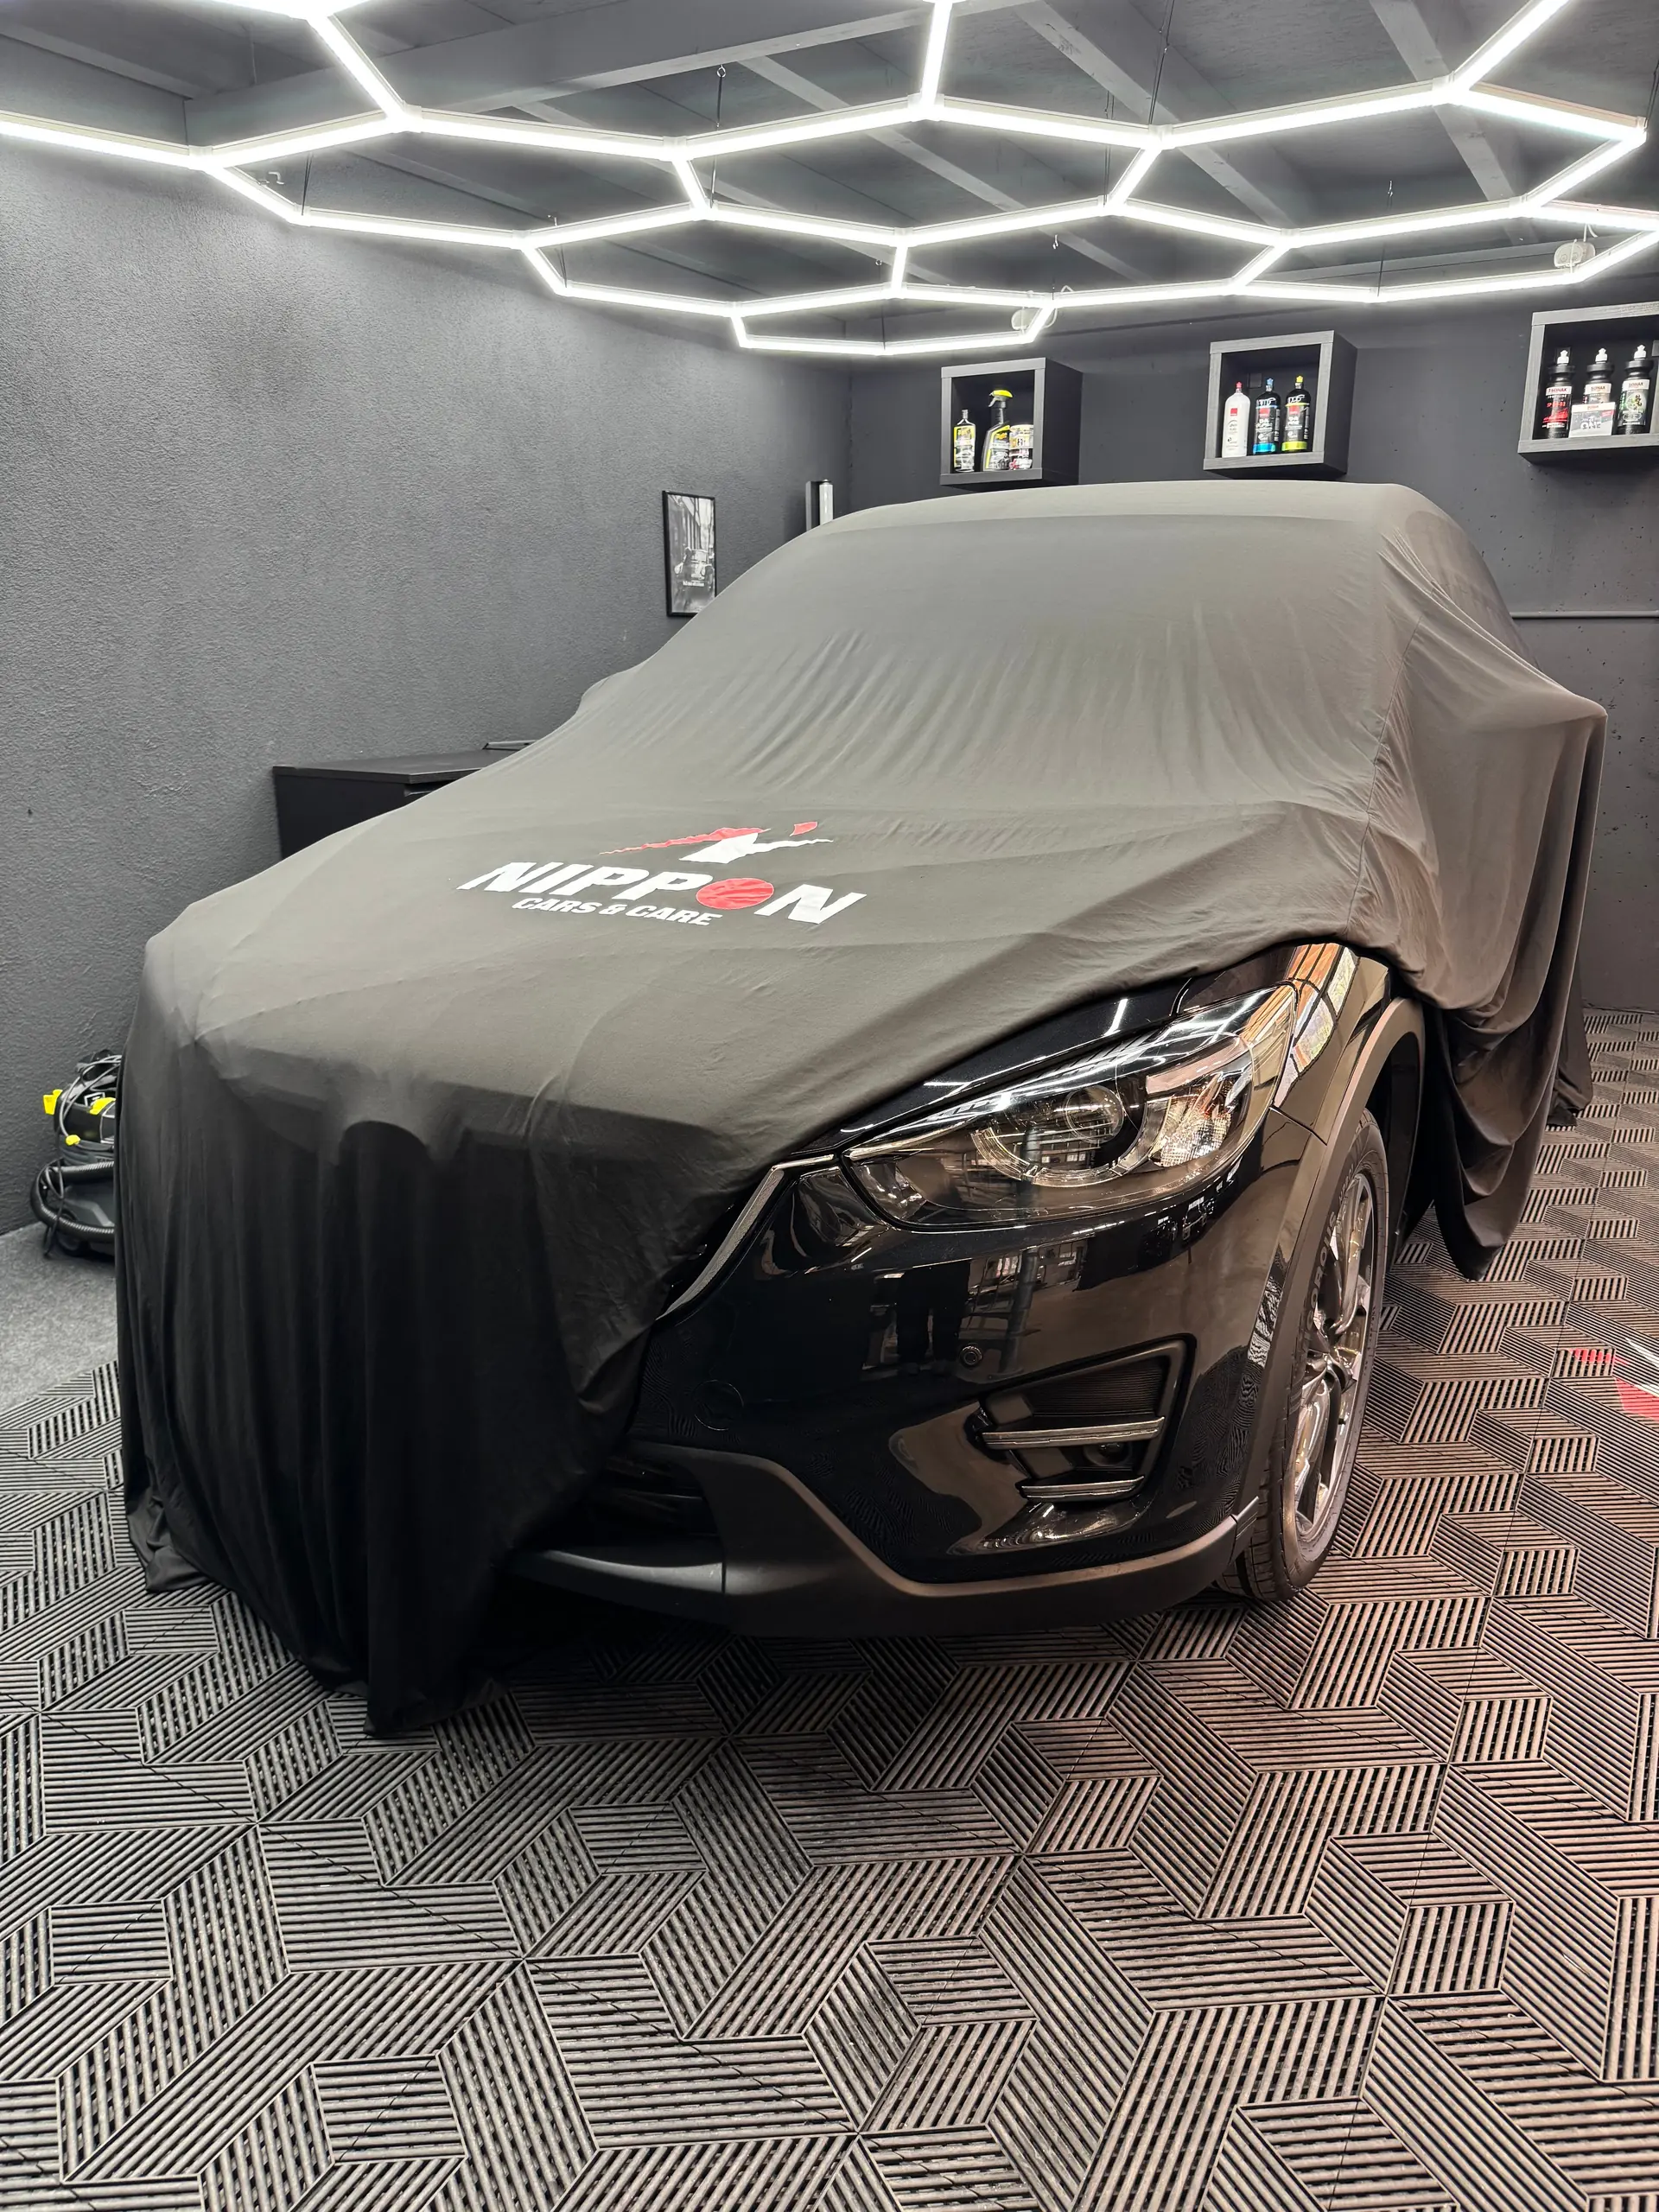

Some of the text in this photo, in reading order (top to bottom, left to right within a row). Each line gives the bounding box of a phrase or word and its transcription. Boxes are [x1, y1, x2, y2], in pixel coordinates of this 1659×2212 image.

[456, 862, 867, 924] NIPPON
[512, 898, 722, 925] CARS & CARE
